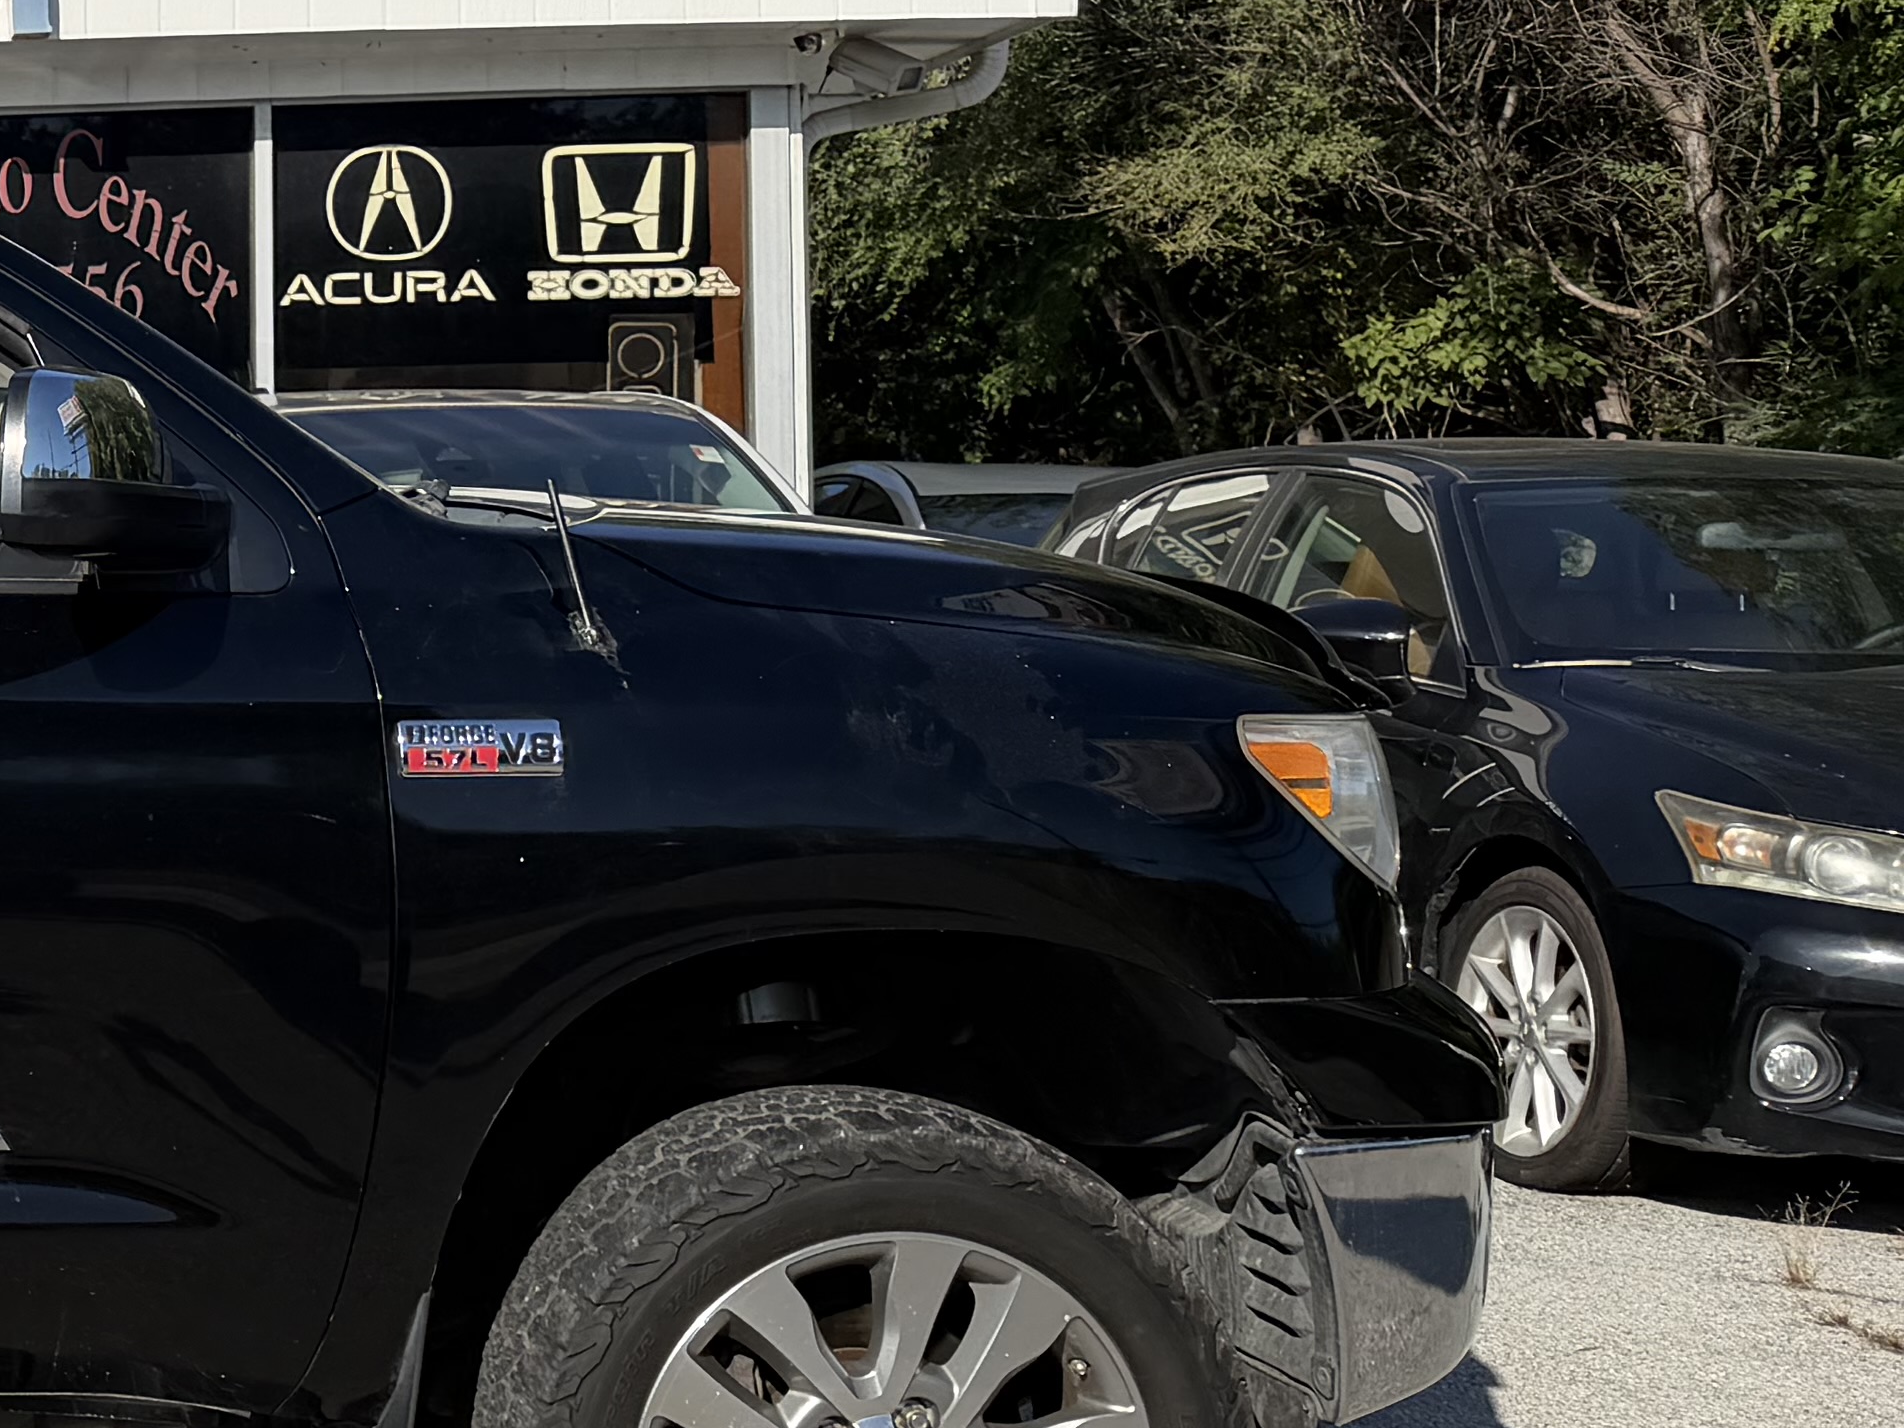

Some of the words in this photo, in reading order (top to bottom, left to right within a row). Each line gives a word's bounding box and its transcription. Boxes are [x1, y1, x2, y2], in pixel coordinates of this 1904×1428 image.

[52, 128, 239, 324] Center
[279, 268, 497, 307] ACURA
[526, 265, 741, 302] HONDA
[499, 731, 557, 765] V8
